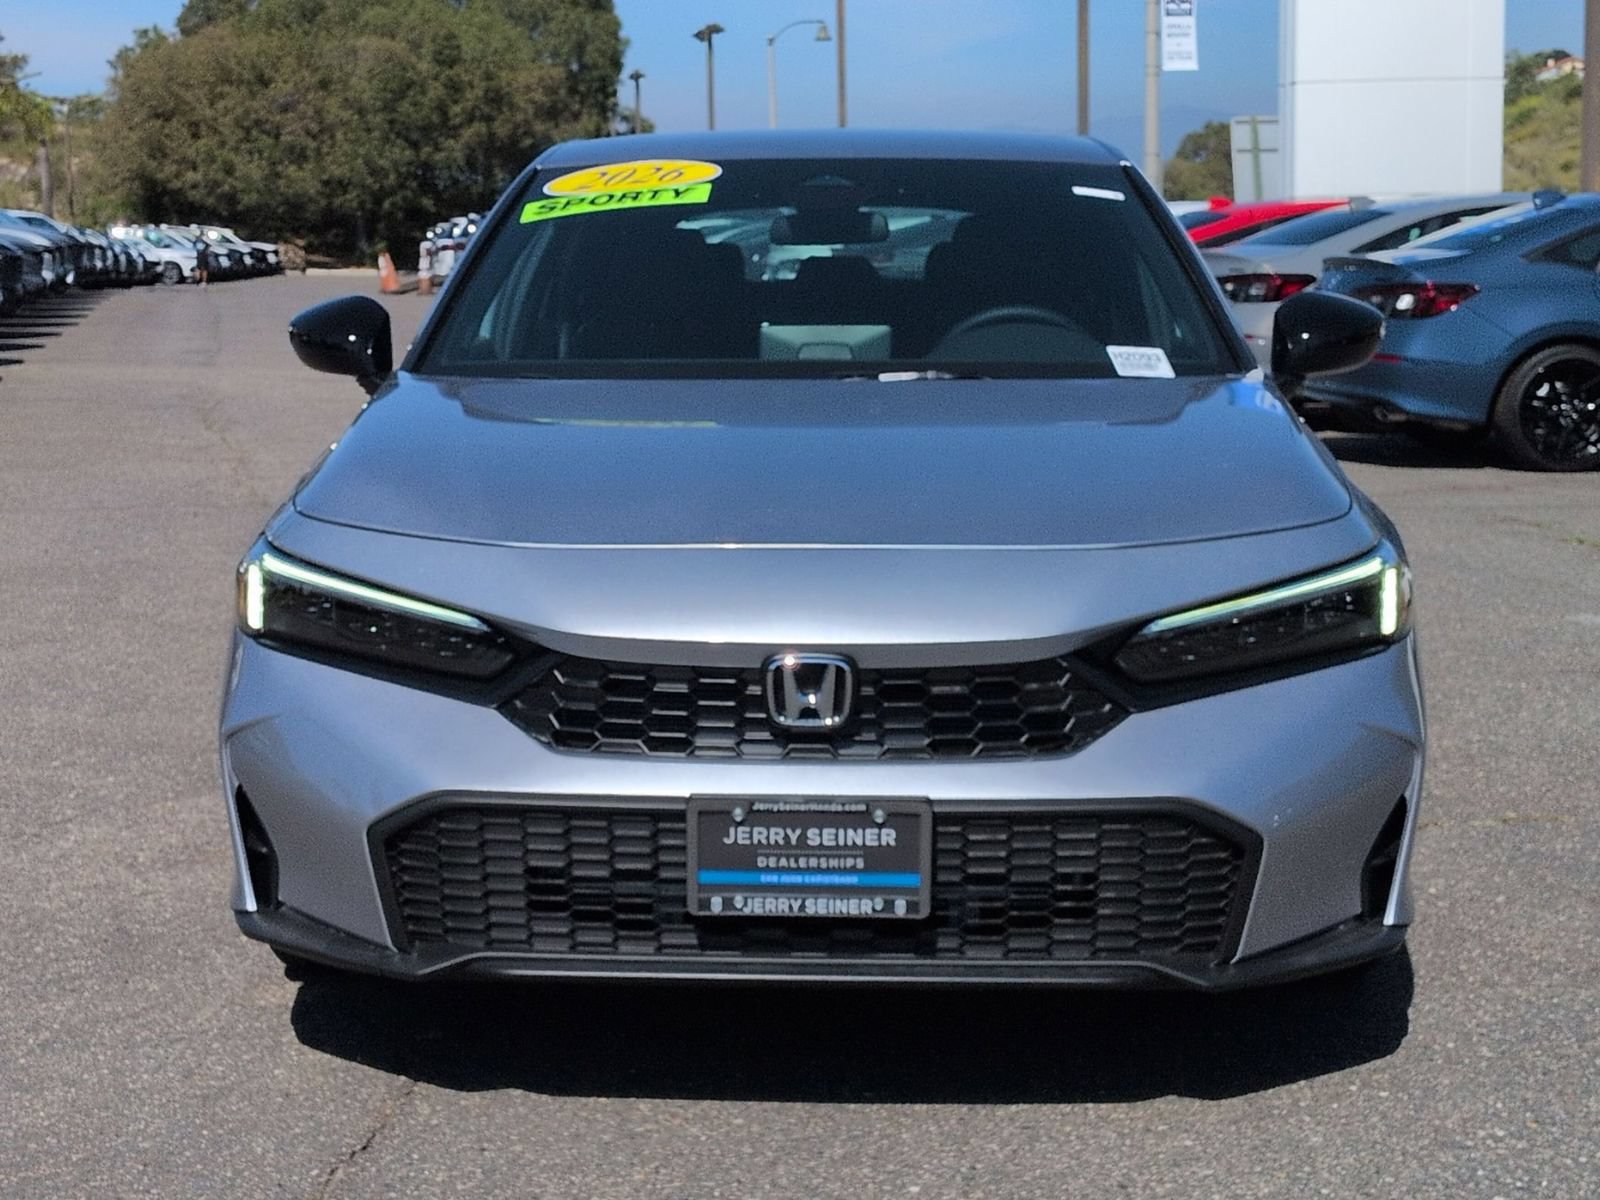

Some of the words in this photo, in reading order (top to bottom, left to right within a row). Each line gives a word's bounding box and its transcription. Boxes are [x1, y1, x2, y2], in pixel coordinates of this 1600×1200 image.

[572, 165, 695, 191] 2026
[533, 187, 695, 215] SPORTY
[723, 826, 802, 846] JERRY
[806, 827, 897, 847] SEINER
[757, 856, 865, 869] DEALERSHIPS
[742, 897, 802, 914] JERRY
[804, 897, 873, 915] SEINER
